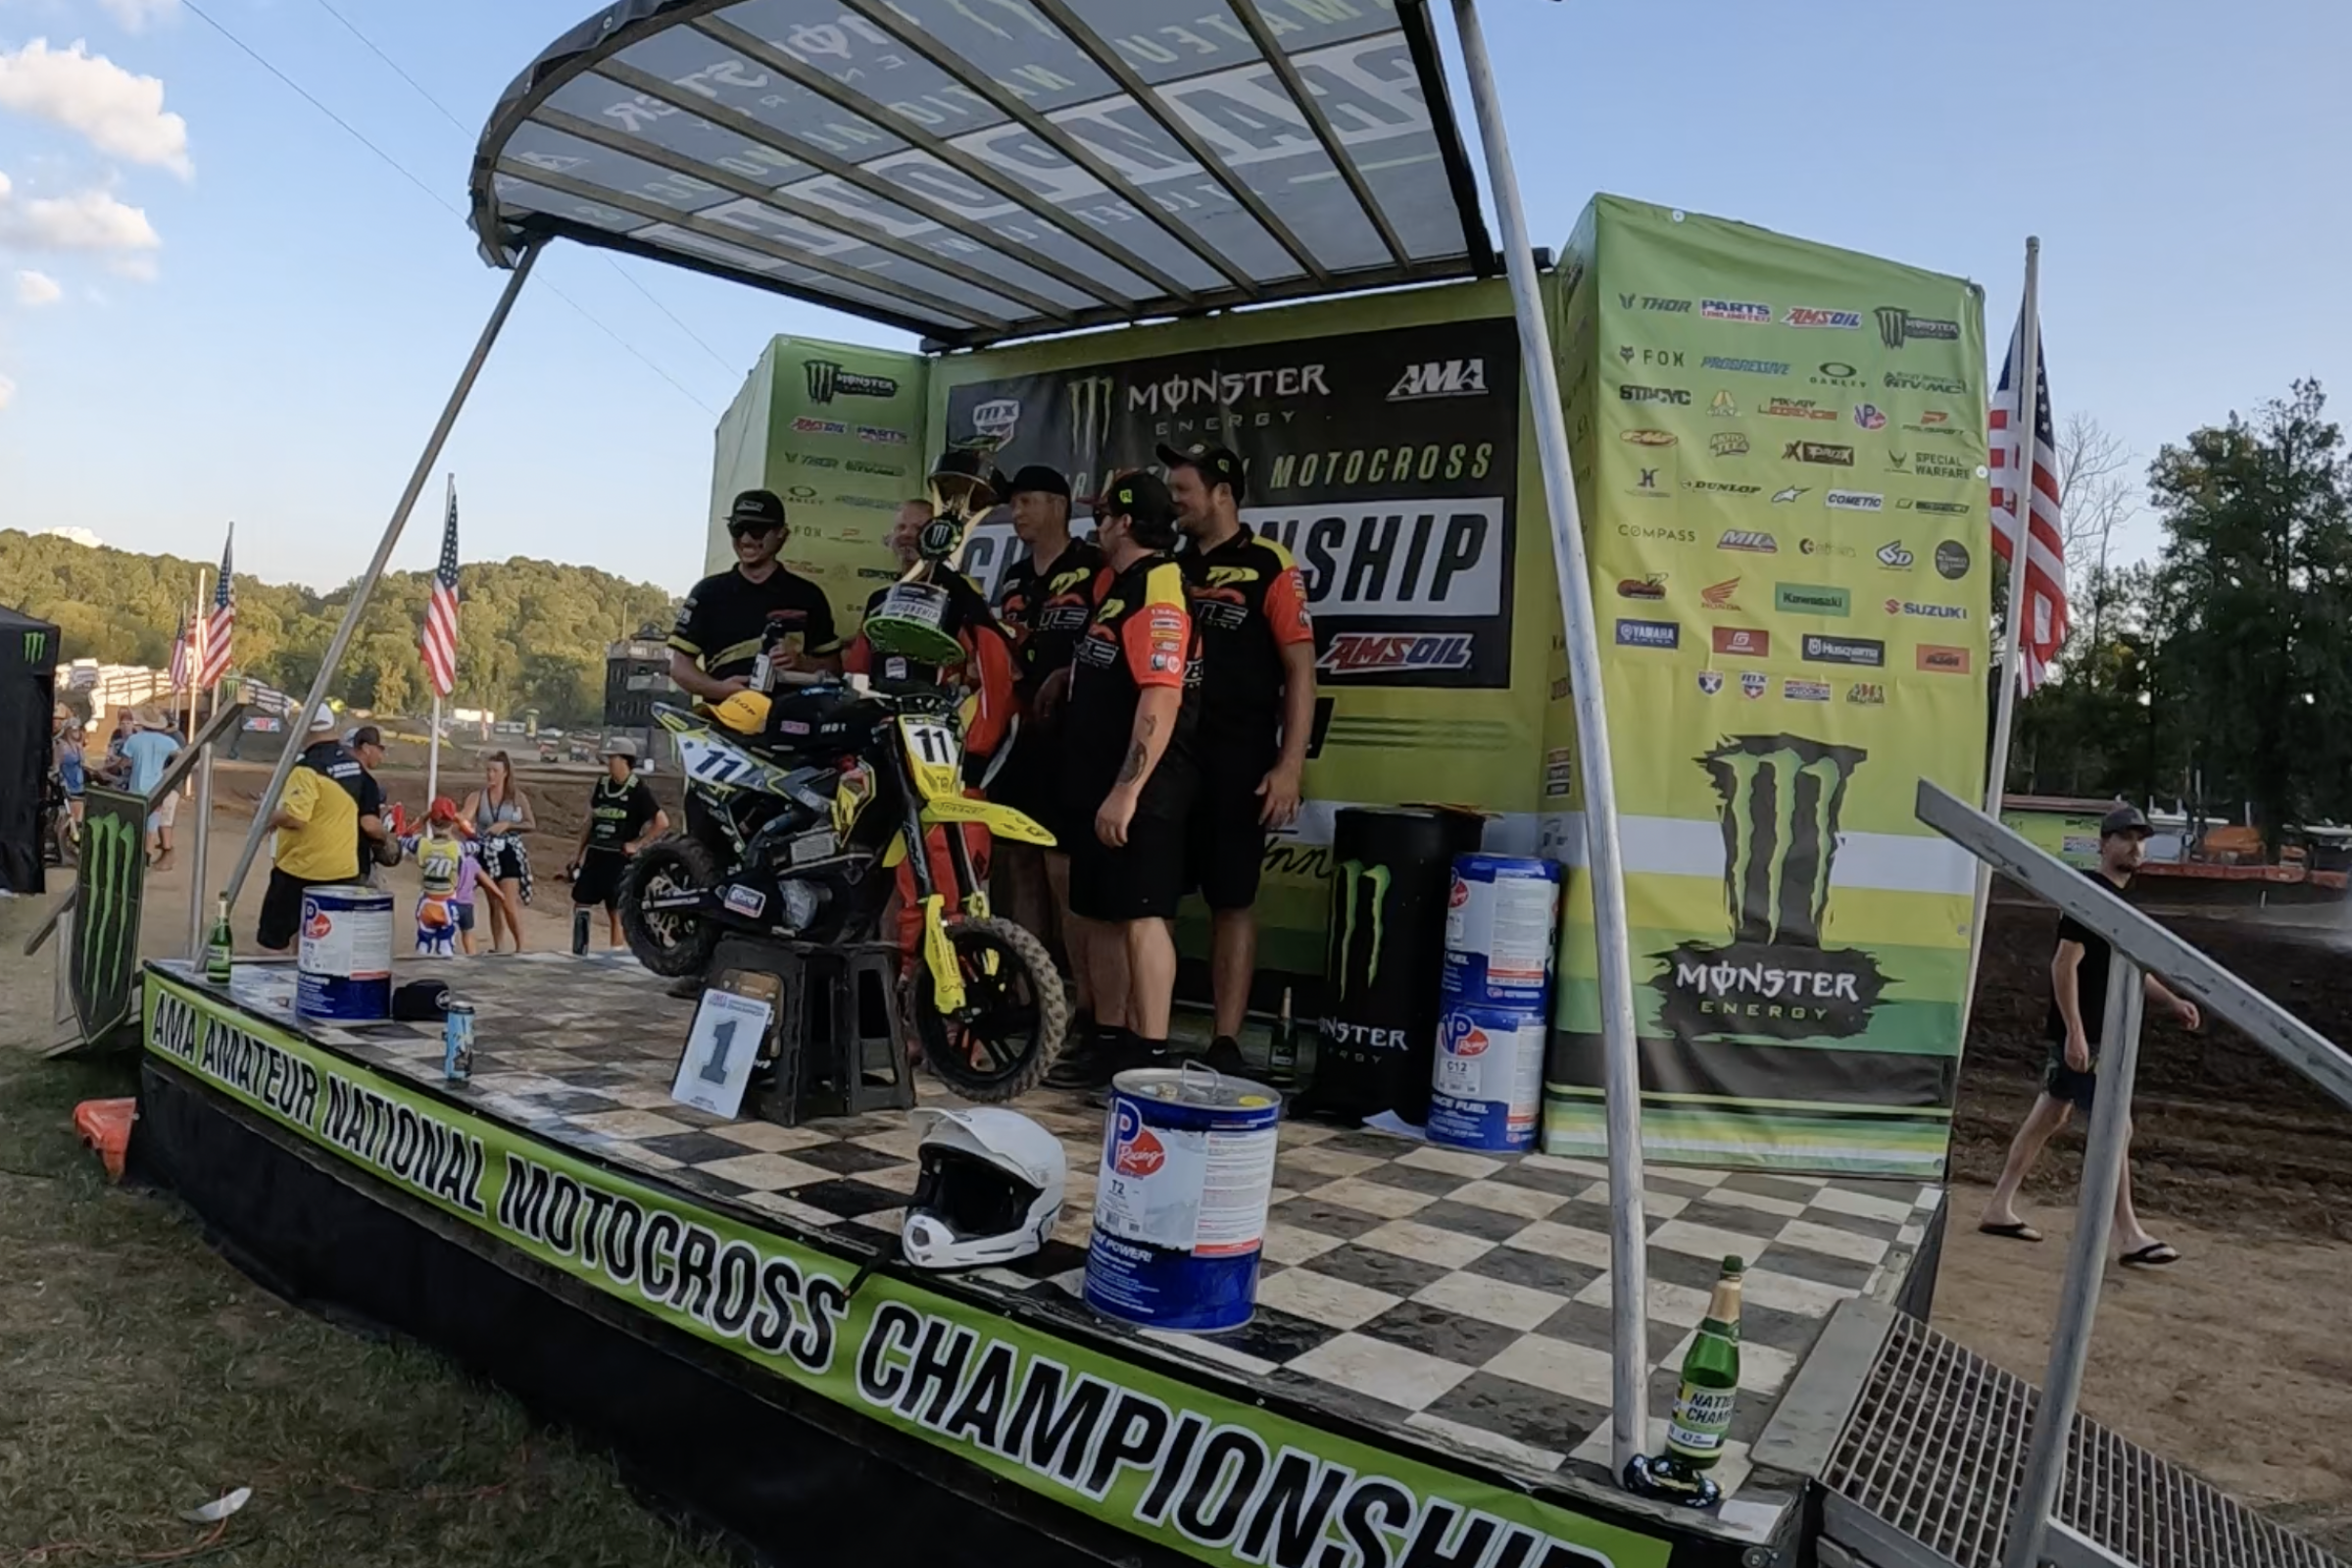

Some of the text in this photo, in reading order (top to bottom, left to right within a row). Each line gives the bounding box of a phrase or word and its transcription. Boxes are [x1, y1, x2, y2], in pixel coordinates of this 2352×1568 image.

[1642, 296, 1691, 313] THOR
[1701, 299, 1770, 315] PARTS
[1785, 307, 1862, 327] AMSOIL
[1643, 349, 1684, 368] FOX
[1700, 355, 1790, 376] PROGRESSIVE
[1389, 357, 1489, 398] AMA
[1155, 411, 1296, 437] ENERGY
[1269, 443, 1494, 489] MOTOCROSS
[1915, 452, 1963, 467] SPECIAL
[1915, 465, 1971, 480] WARFARE
[1694, 480, 1762, 493] DUNLOP
[1827, 493, 1882, 508] COMETIC
[1617, 523, 1695, 542] COMPASS
[1783, 592, 1843, 608] Kawasaki
[1903, 602, 1968, 619] SUZUKI
[1632, 625, 1674, 640] YAMAHA
[1320, 633, 1474, 672] AMSOIL
[1822, 641, 1880, 659] Husqvarna
[913, 728, 953, 765] 11
[694, 748, 742, 781] 11
[1700, 1001, 1829, 1021] ENERGY
[699, 1020, 737, 1085] 1
[1446, 1060, 1468, 1072] C12
[1455, 1099, 1489, 1114] FUEL
[1117, 1143, 1163, 1169] Racing
[1110, 1179, 1125, 1196] T2
[1106, 1238, 1152, 1263] POWER!
[153, 989, 1617, 1568] AMA AMATEUR NATIONAL MOTOCROSS CHAMPIONSH
